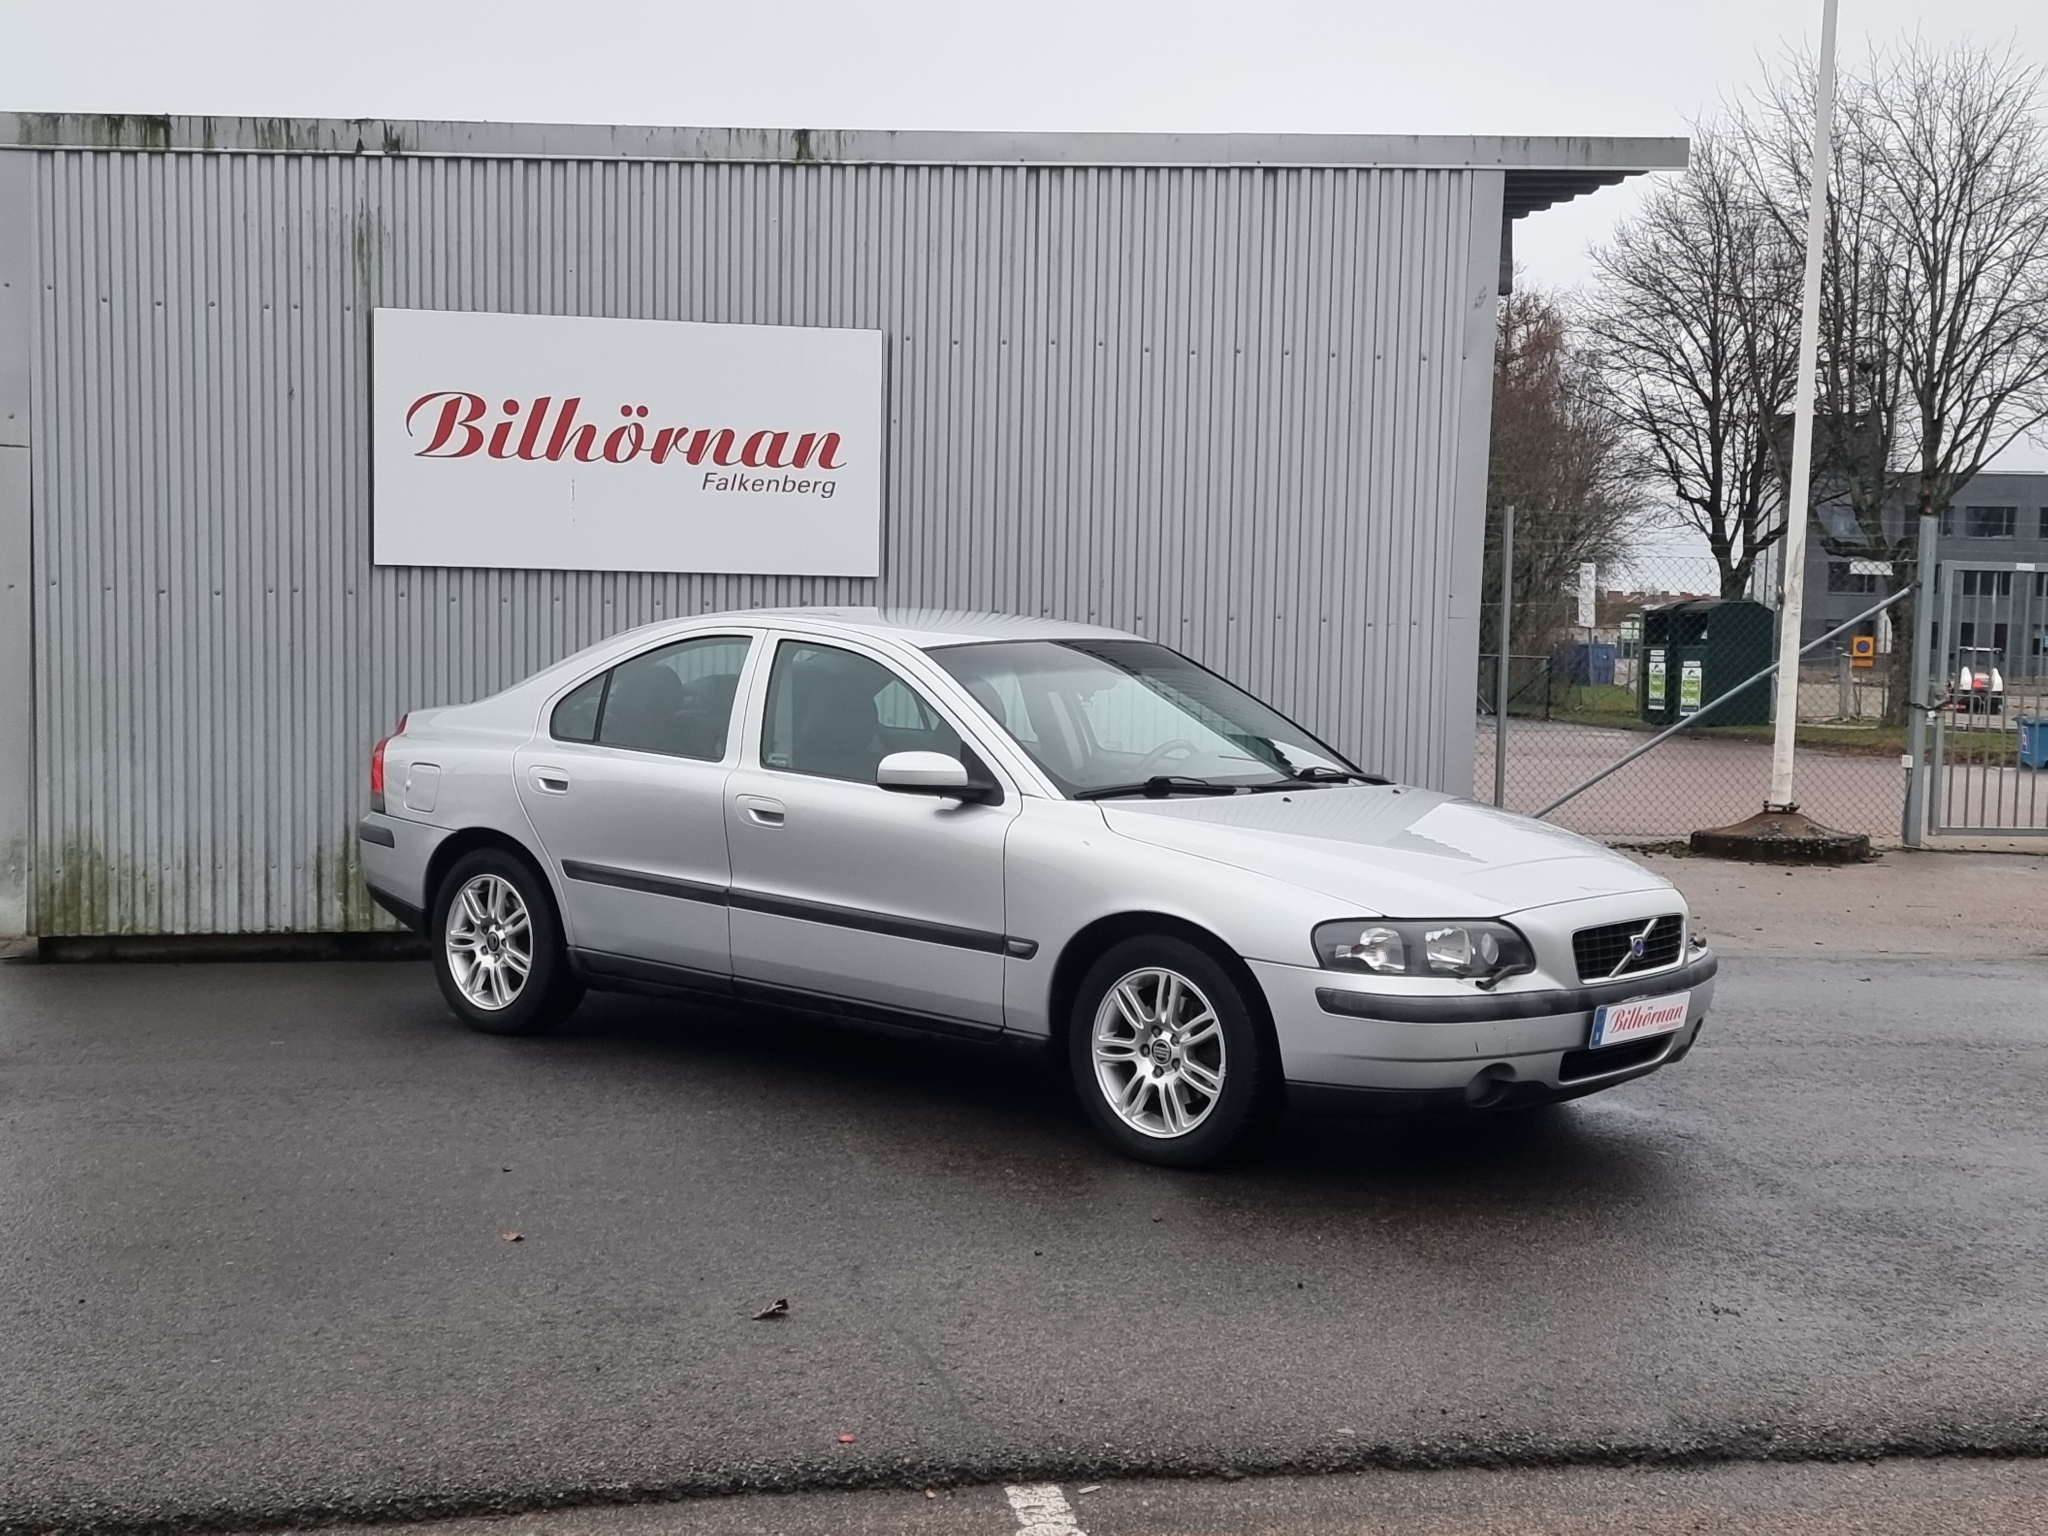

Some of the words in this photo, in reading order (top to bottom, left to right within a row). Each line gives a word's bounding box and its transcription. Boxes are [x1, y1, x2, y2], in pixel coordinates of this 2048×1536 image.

[406, 391, 848, 469] Bilhörnan
[702, 472, 837, 498] Falkenberg
[1609, 1005, 1684, 1034] Bilhörnan
